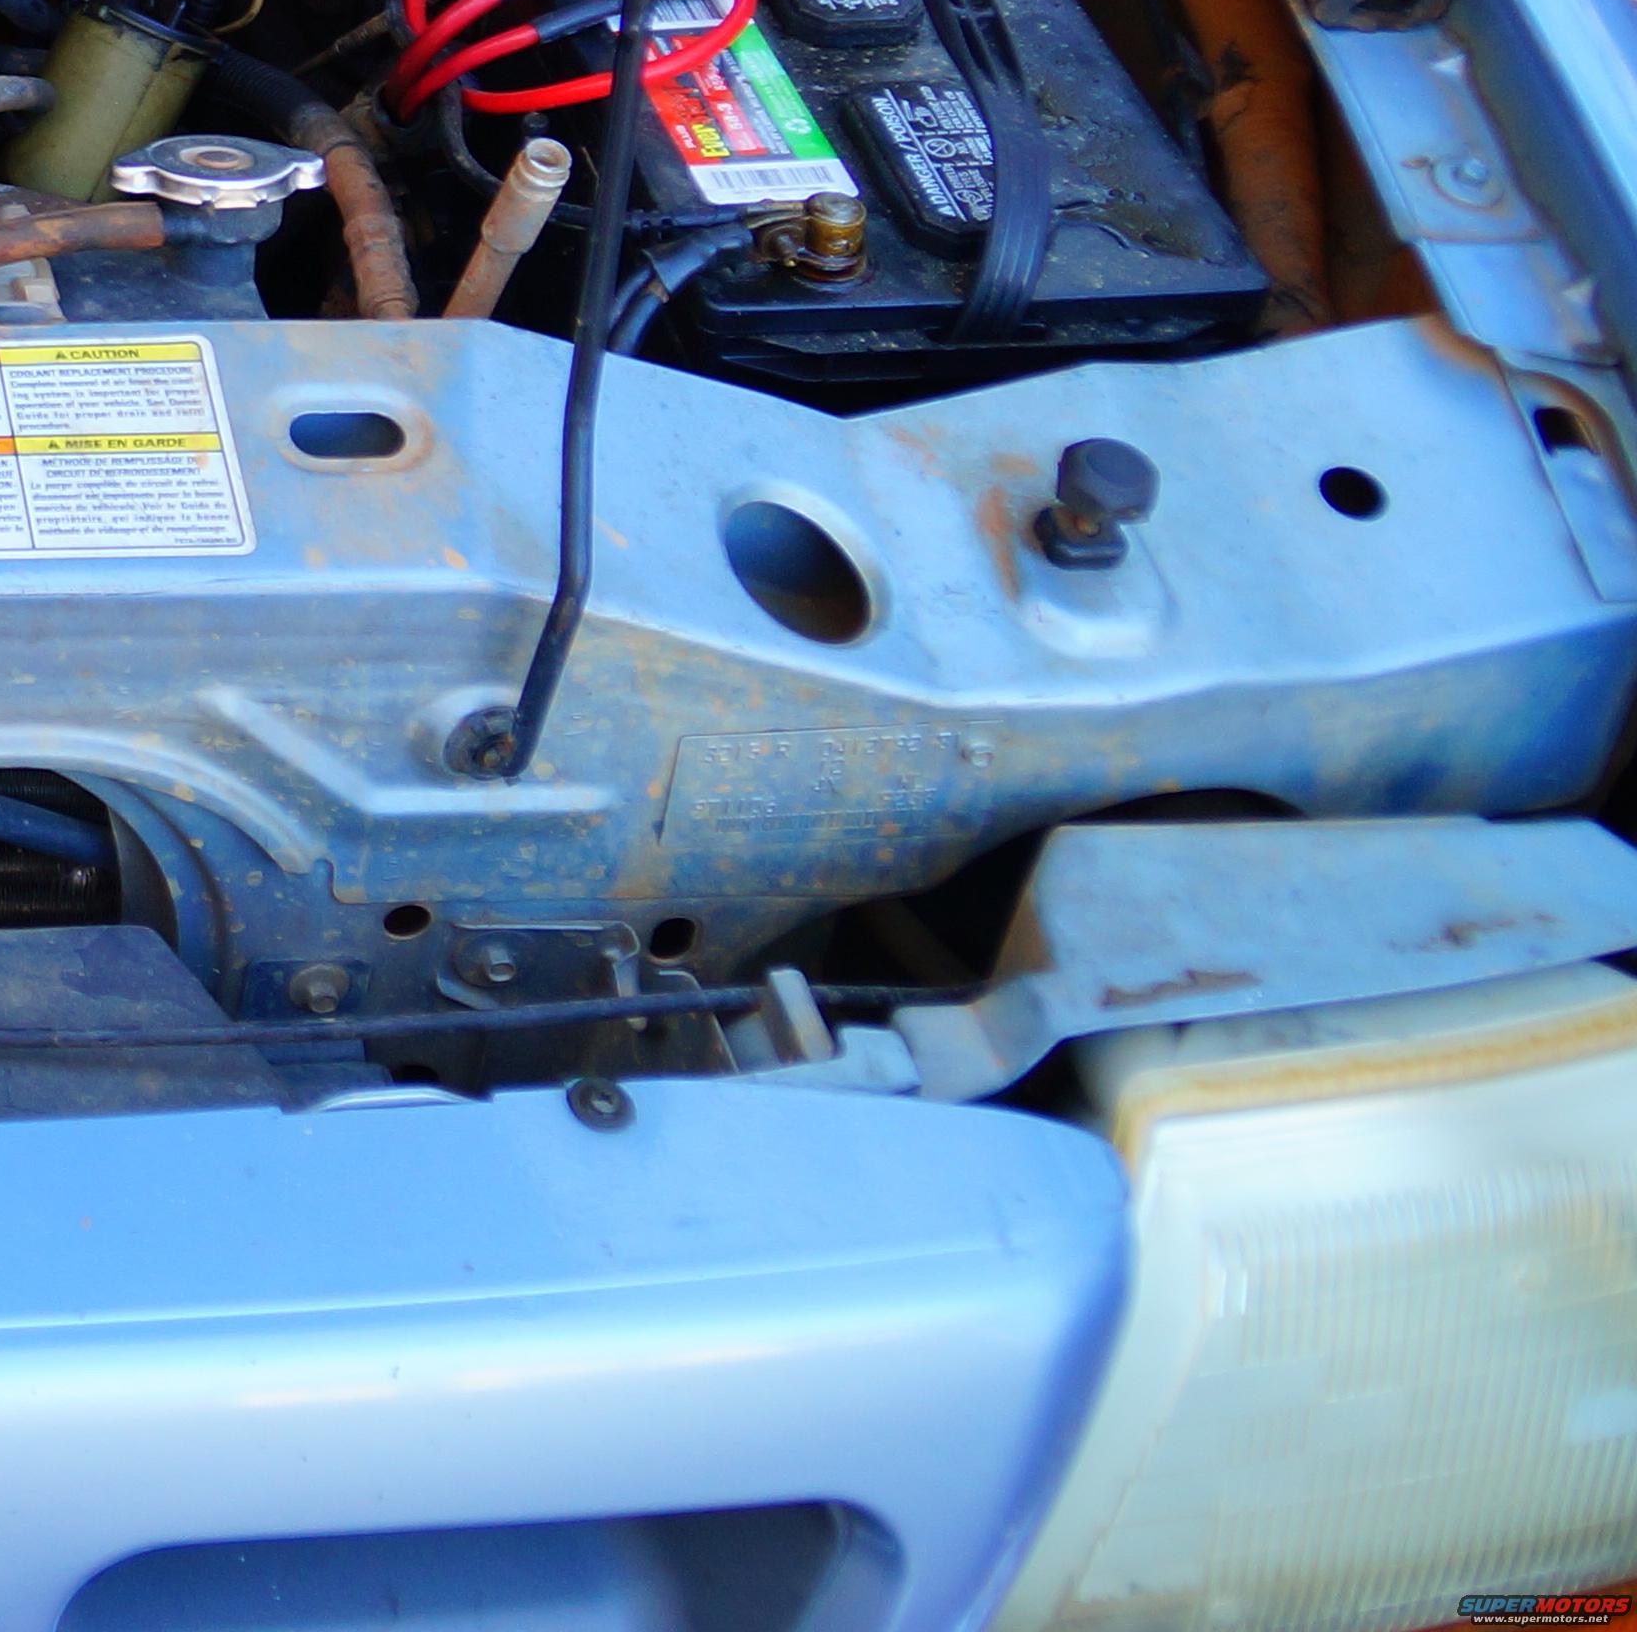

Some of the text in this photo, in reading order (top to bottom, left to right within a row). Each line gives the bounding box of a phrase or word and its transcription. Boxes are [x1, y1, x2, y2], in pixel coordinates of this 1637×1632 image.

[69, 349, 139, 359] CAUTION
[64, 437, 186, 449] MISE EN GARDE
